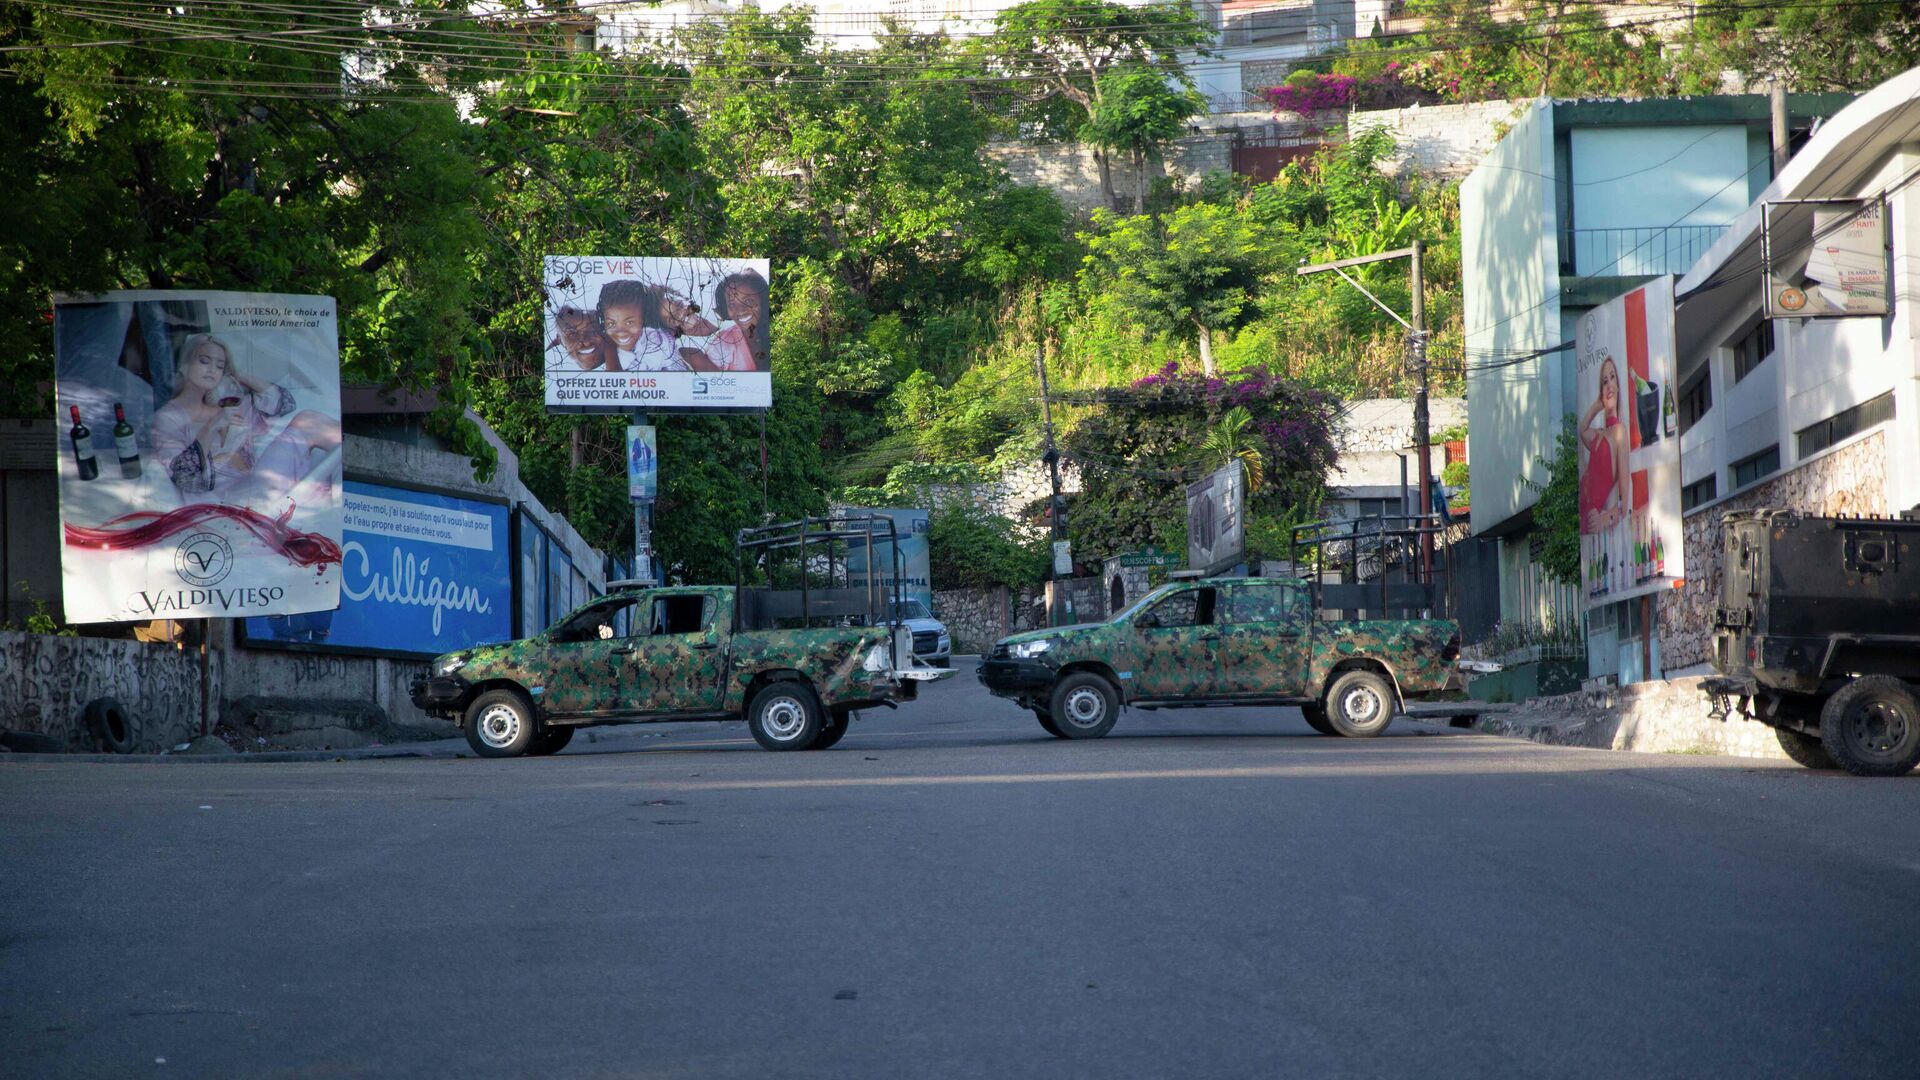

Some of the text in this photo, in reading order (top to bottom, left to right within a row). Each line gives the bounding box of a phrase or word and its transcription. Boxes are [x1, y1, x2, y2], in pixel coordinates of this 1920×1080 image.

[214, 306, 330, 317] VALDIVIESO, le choix de
[228, 319, 320, 328] Miss World America!
[556, 378, 657, 388] OFFREZ LEUR PLUS
[710, 378, 737, 386] SOGE
[556, 389, 670, 400] QUE VOTRE AMOUR.
[343, 499, 389, 516] Appelez-moi,
[399, 507, 406, 517] la
[406, 508, 432, 521] solution
[433, 513, 447, 525] qu'il
[447, 517, 462, 526] vous
[474, 521, 489, 531] pour
[343, 515, 353, 525] de
[353, 516, 370, 527] l'eau
[371, 519, 394, 532] propre
[394, 523, 403, 532] et
[403, 524, 420, 535] saine
[421, 526, 436, 536] chez
[127, 586, 285, 615] VALDIVIESO
